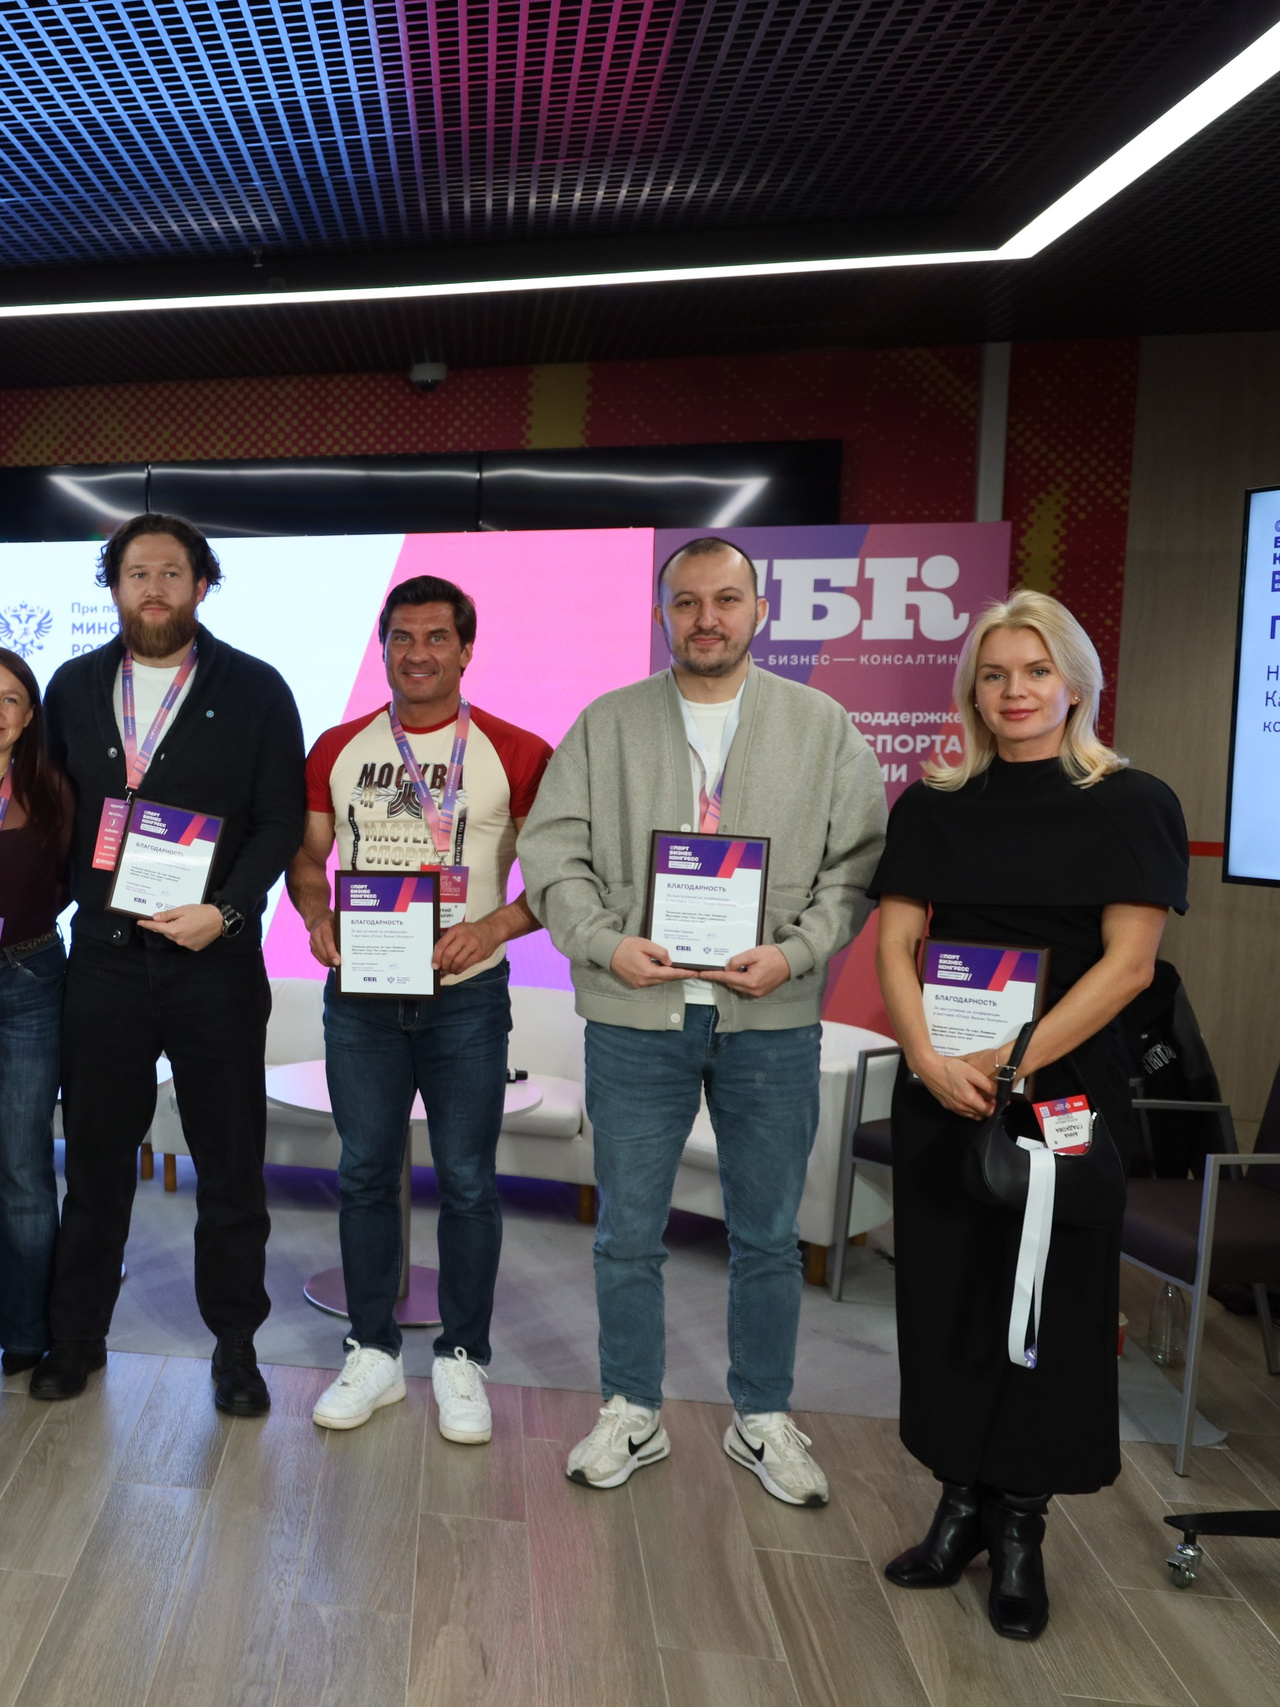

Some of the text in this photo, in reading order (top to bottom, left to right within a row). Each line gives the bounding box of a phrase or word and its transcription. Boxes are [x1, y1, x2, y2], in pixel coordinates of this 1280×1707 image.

[71, 602, 97, 615] При
[768, 654, 960, 665] БИЗНЕС КОНСАЛТИН
[136, 842, 184, 857] БЛАГОДАРНОСТЬ
[667, 883, 727, 892] БЛАГОДАРНОСТЬ
[938, 958, 963, 966] БИЗНЕС
[938, 964, 969, 972] КОНГРЕСС
[935, 994, 997, 1006] БЛАГОДАРНОСТЬ
